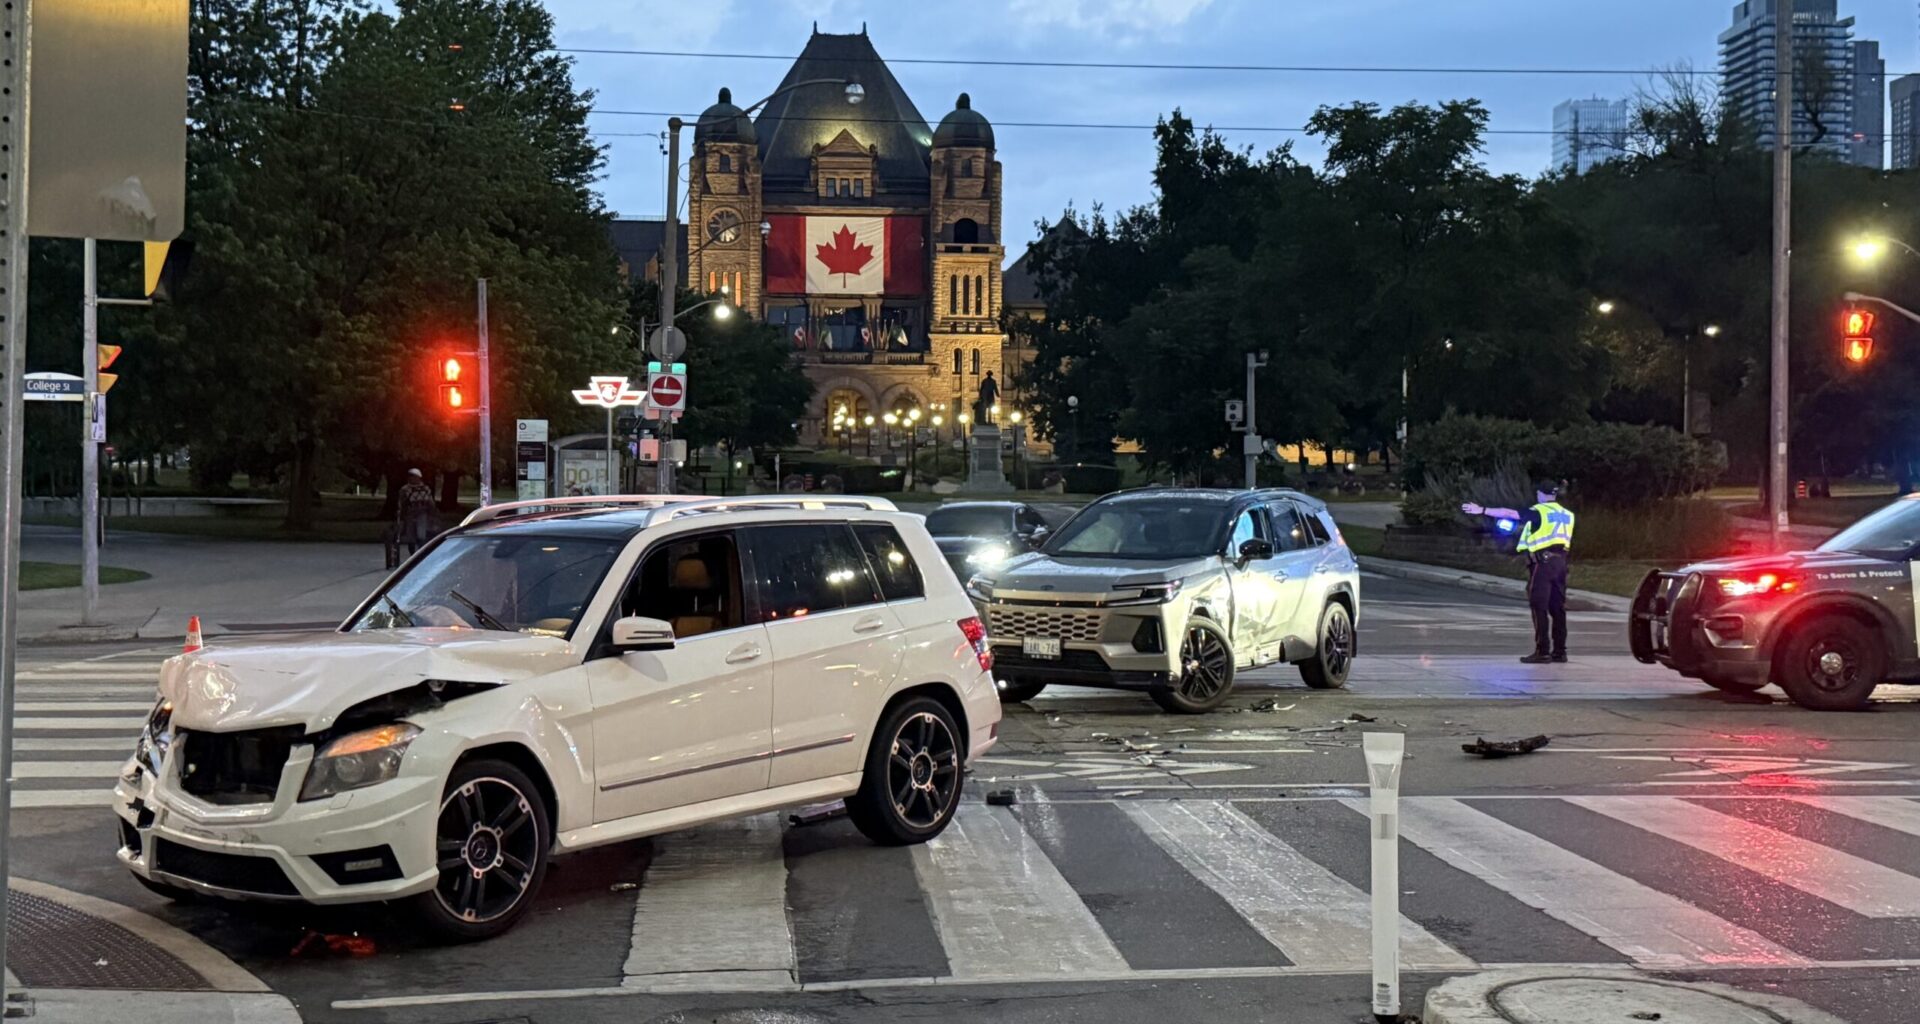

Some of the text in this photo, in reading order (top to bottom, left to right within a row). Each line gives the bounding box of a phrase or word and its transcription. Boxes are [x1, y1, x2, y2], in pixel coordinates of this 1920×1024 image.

[27, 380, 70, 392] College St
[1868, 569, 1904, 578] Protect
